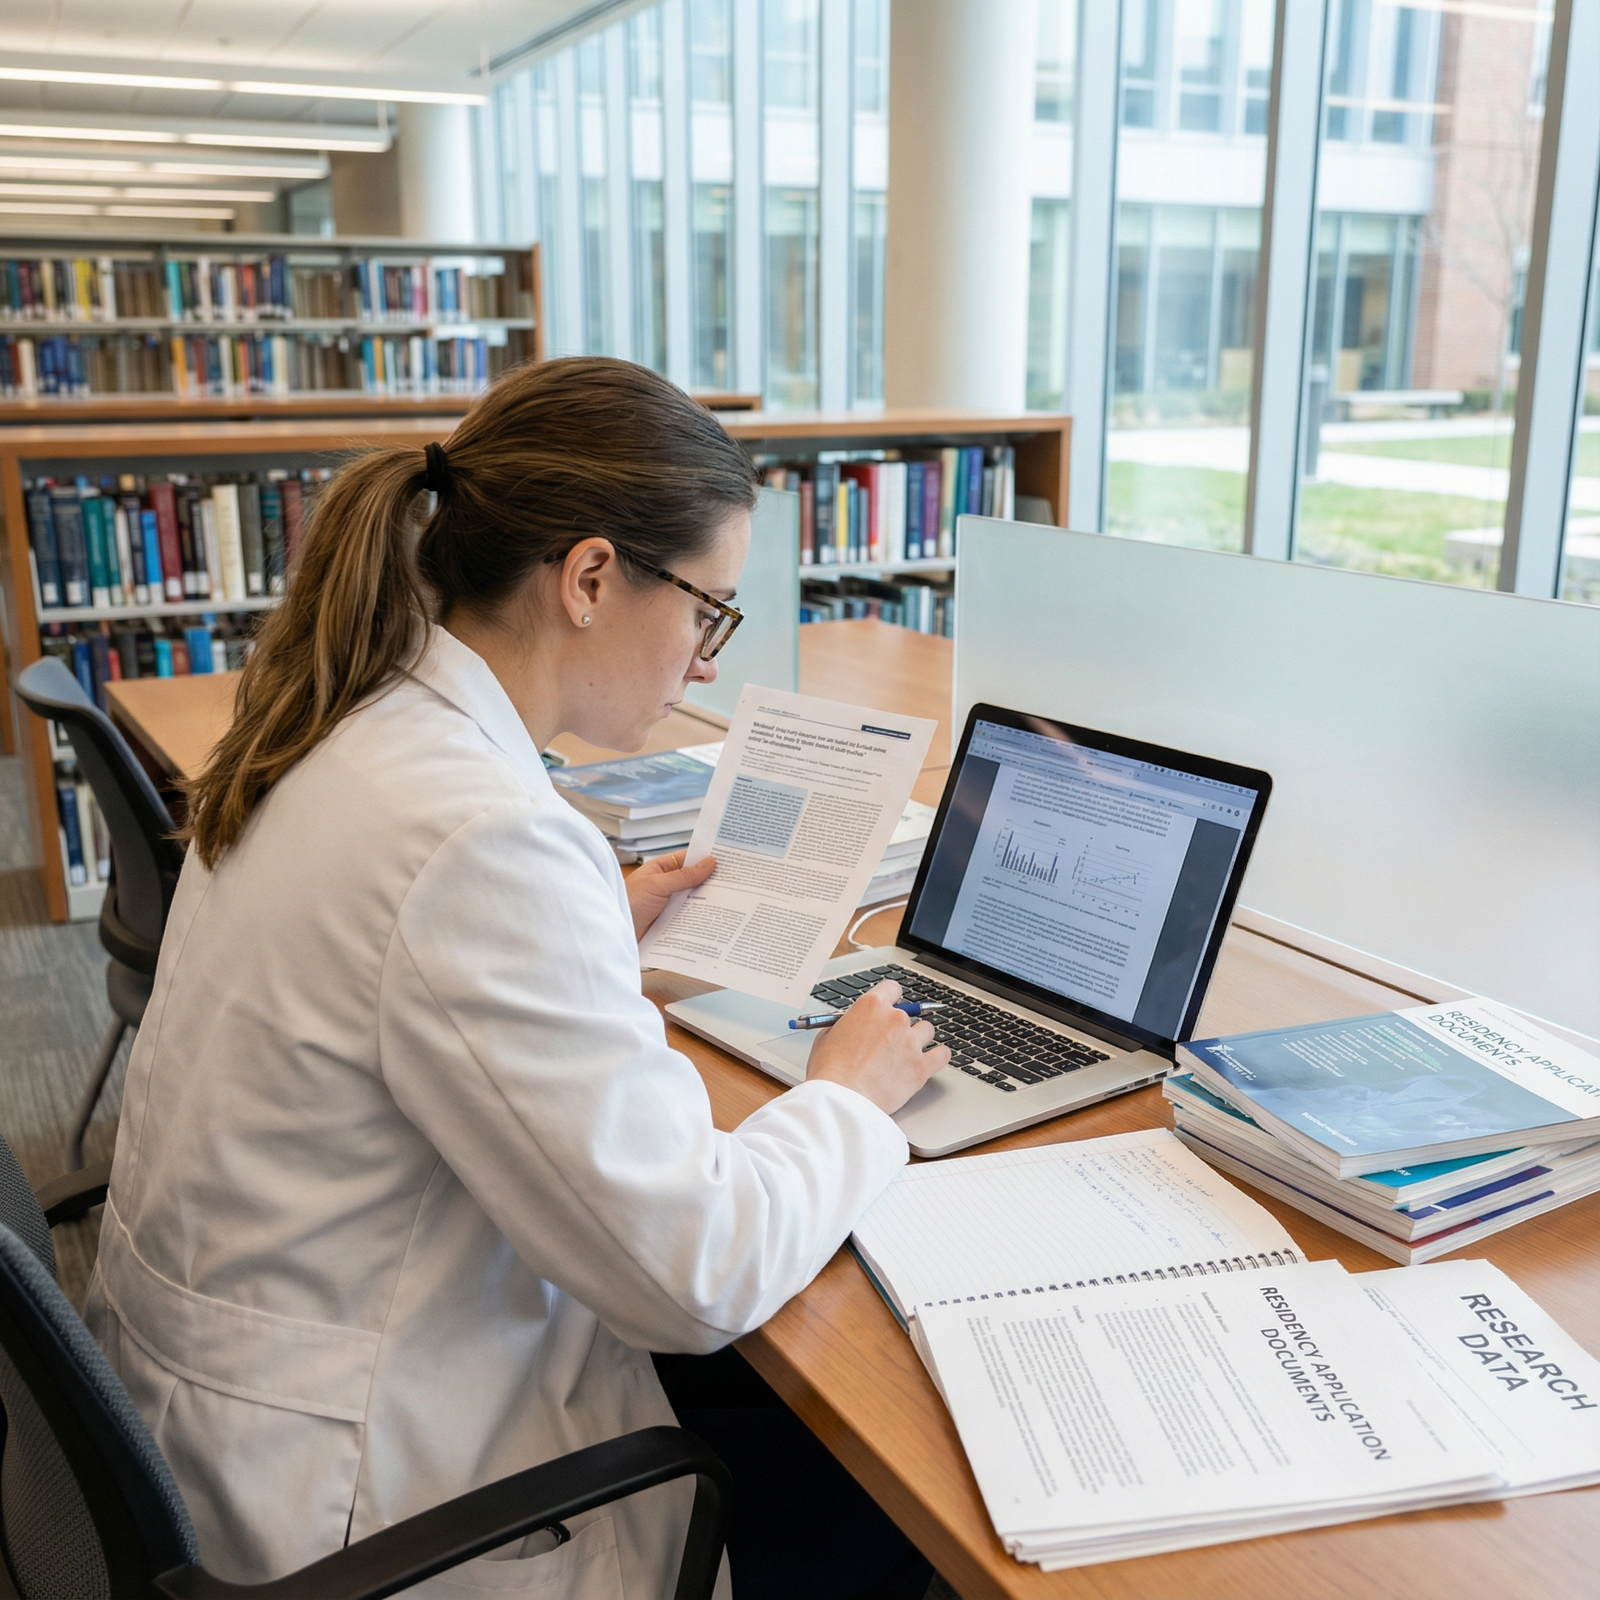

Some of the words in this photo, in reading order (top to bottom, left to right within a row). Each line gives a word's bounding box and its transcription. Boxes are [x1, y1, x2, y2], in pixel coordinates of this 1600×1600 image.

[1427, 1014, 1522, 1066] DOCUMENTS
[1446, 1010, 1531, 1054] RESIDENCY
[1259, 1286, 1323, 1358] RESIDENCY
[1311, 1362, 1391, 1460] APPLICATION
[1260, 1327, 1335, 1422] DOCUMENTS
[1457, 1333, 1530, 1391] DATA
[1459, 1293, 1599, 1410] RESEARCH
